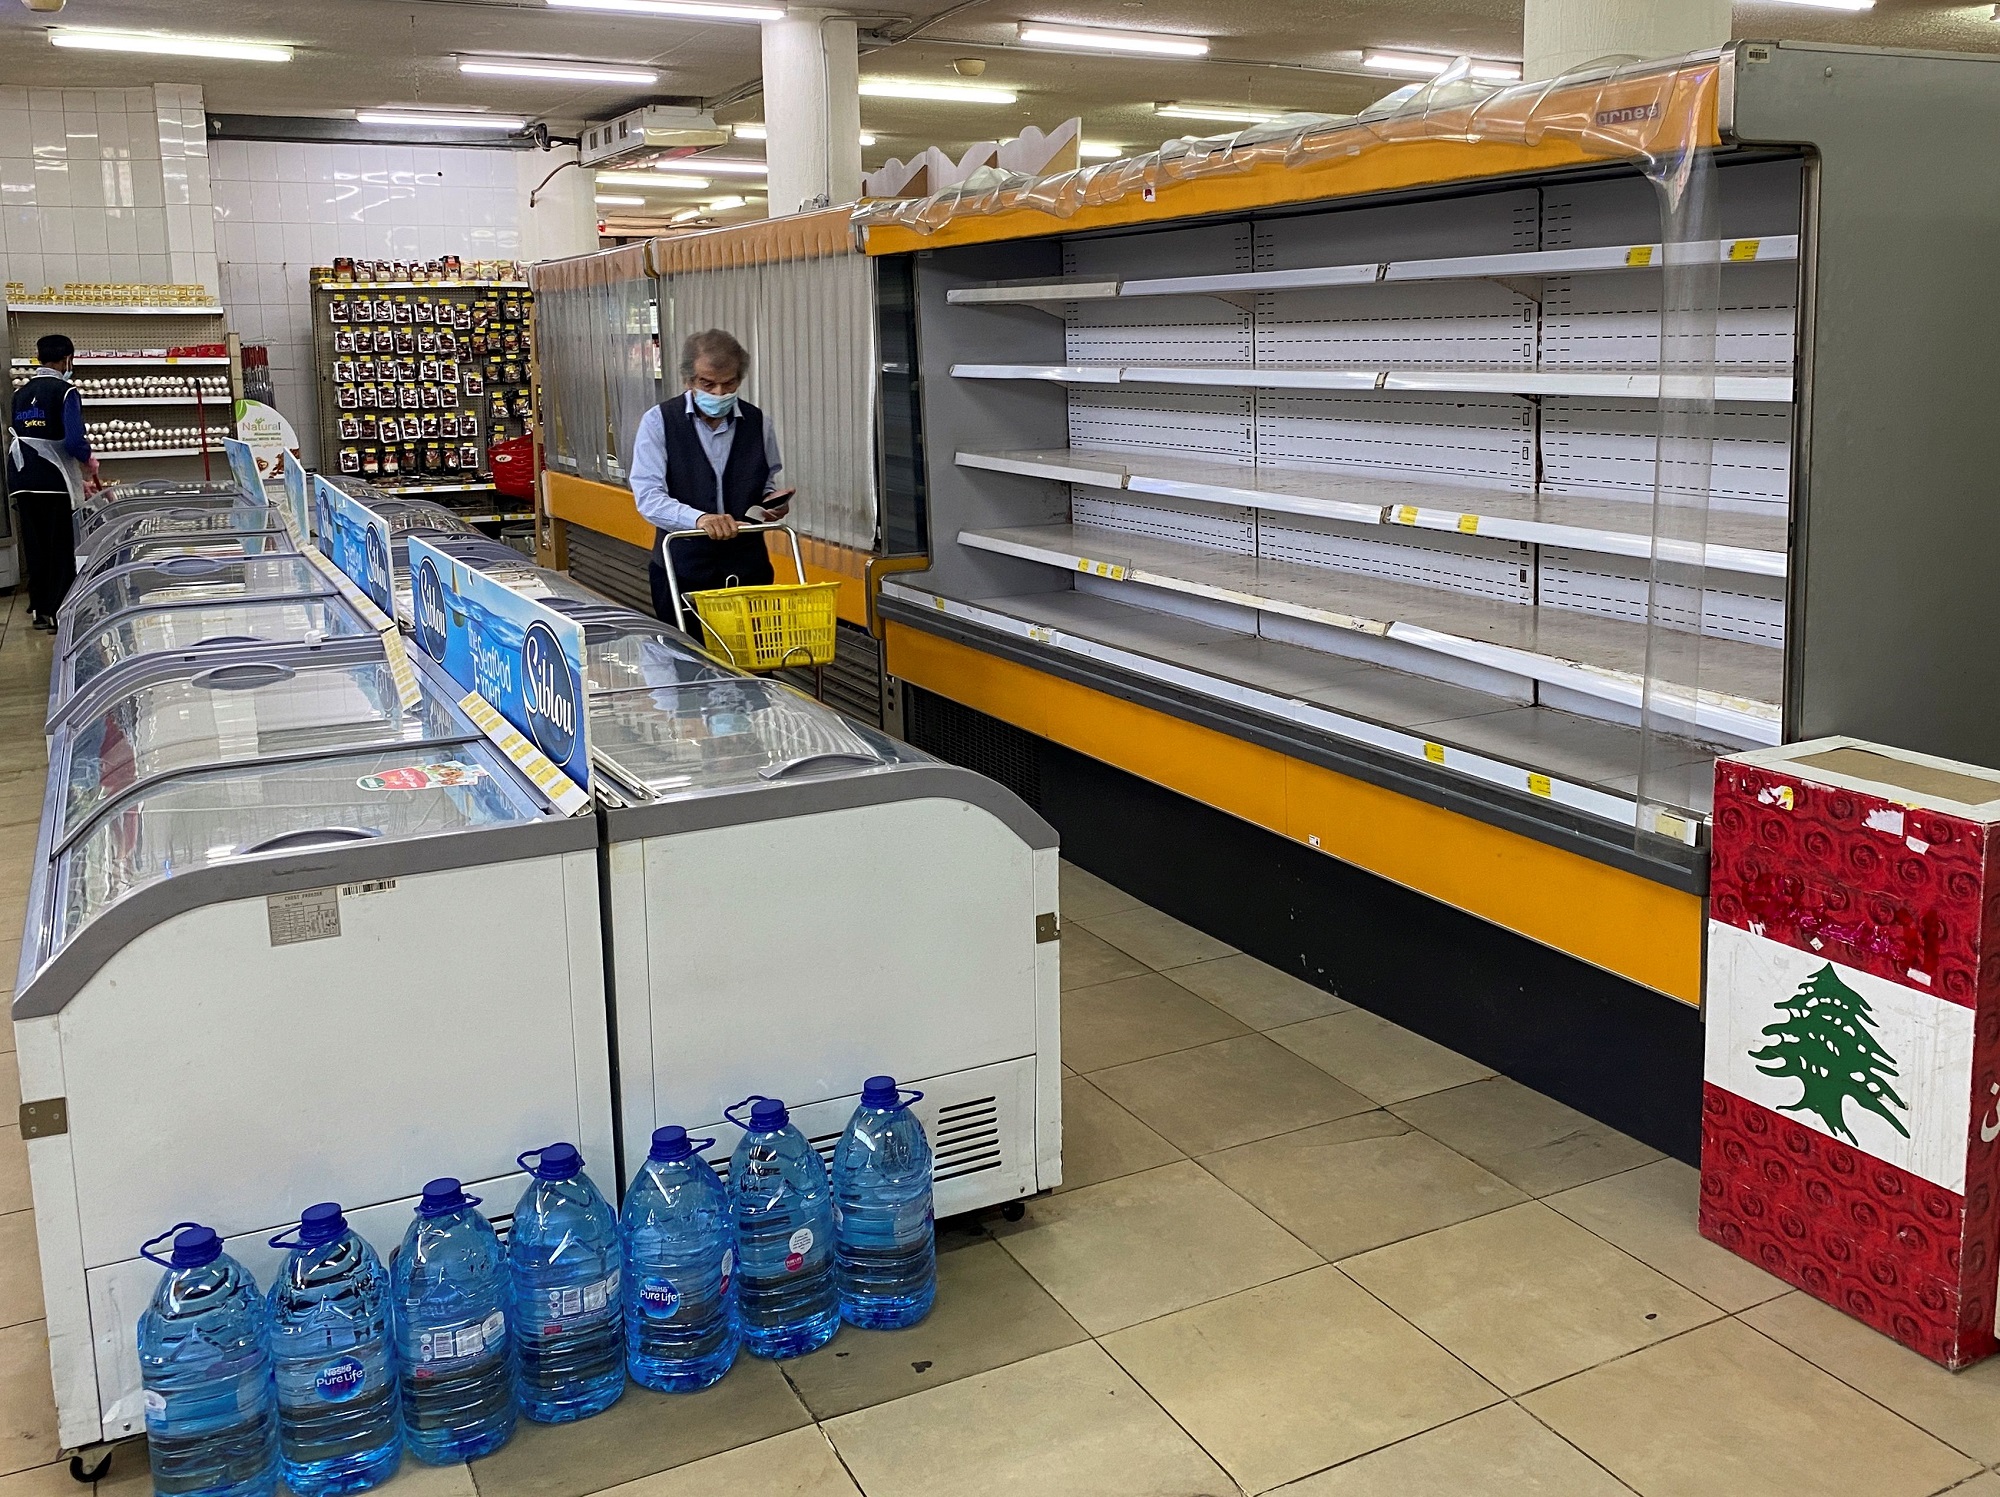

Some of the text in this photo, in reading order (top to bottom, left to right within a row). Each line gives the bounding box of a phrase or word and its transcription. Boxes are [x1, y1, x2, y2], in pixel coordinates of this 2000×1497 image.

[242, 422, 281, 431] Natural
[420, 569, 447, 638] Siblou
[525, 636, 575, 737] Siblou
[640, 1289, 678, 1306] Pure Life
[316, 1369, 363, 1387] Pure Life
